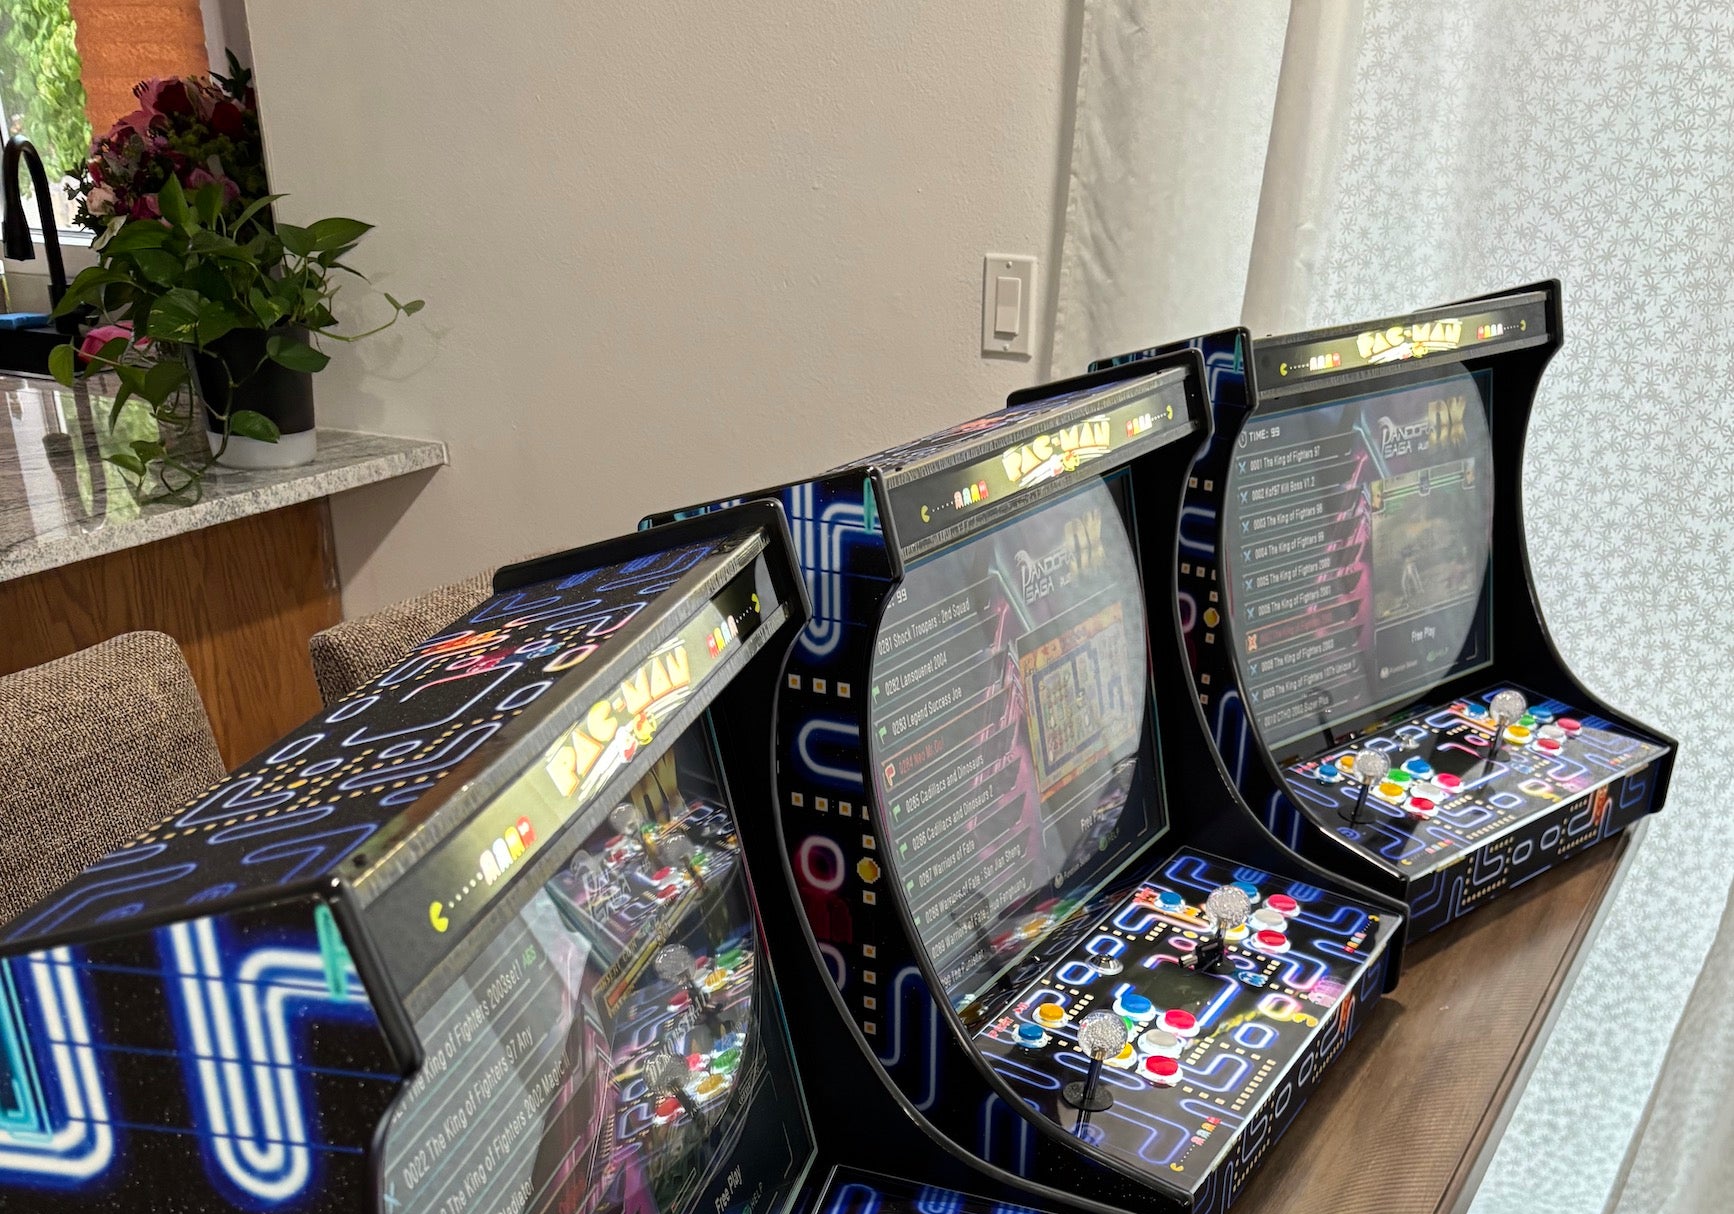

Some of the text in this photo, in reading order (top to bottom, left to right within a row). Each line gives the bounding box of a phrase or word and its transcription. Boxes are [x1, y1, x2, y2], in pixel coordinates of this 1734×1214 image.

[1357, 322, 1462, 359] PAC-MAN
[1002, 421, 1110, 482] PAC-MAN
[1249, 427, 1280, 442] TIME: 99
[1264, 457, 1273, 468] The
[1274, 454, 1286, 466] King
[1293, 449, 1313, 462] Fighters
[1267, 515, 1276, 526] The
[1277, 513, 1289, 524] King
[1296, 507, 1315, 520] Fighters
[1269, 544, 1278, 556] The
[1279, 541, 1290, 552] King
[1015, 550, 1076, 595] PANDORA
[1025, 576, 1054, 605] SAGA
[896, 588, 907, 604] 99
[878, 597, 970, 656] 0281 Shock Troopers 2nd Squad
[884, 651, 948, 696] 0282 Lansquenet 2004
[546, 646, 690, 797] PAC-MAN
[892, 687, 962, 736] 0283 Legend Success Joe
[905, 755, 984, 813] 0285 Cadillacs and Dinosaurs
[912, 831, 927, 851] 0286
[926, 816, 953, 840] Cadillacs
[953, 806, 963, 823] and
[963, 790, 990, 816] Dinosaurs
[919, 840, 975, 888] 0287 Warriors of Fate
[962, 880, 969, 897] of
[968, 874, 981, 892] Fate
[983, 865, 994, 879] San
[994, 856, 1005, 872] Jian
[1004, 844, 1021, 862] Sheng
[945, 924, 968, 949] Warriors
[424, 959, 524, 1084] King of Fighters 2003set1
[403, 1026, 533, 1190] 0022 The King of Fighters 97 Any
[463, 1165, 487, 1198] King
[484, 1146, 497, 1172] of
[492, 1111, 527, 1157] Fighters
[523, 1085, 544, 1120] 2002
[541, 1058, 565, 1097] Magic
[727, 1164, 743, 1194] Play
[750, 1181, 764, 1212] HELP
